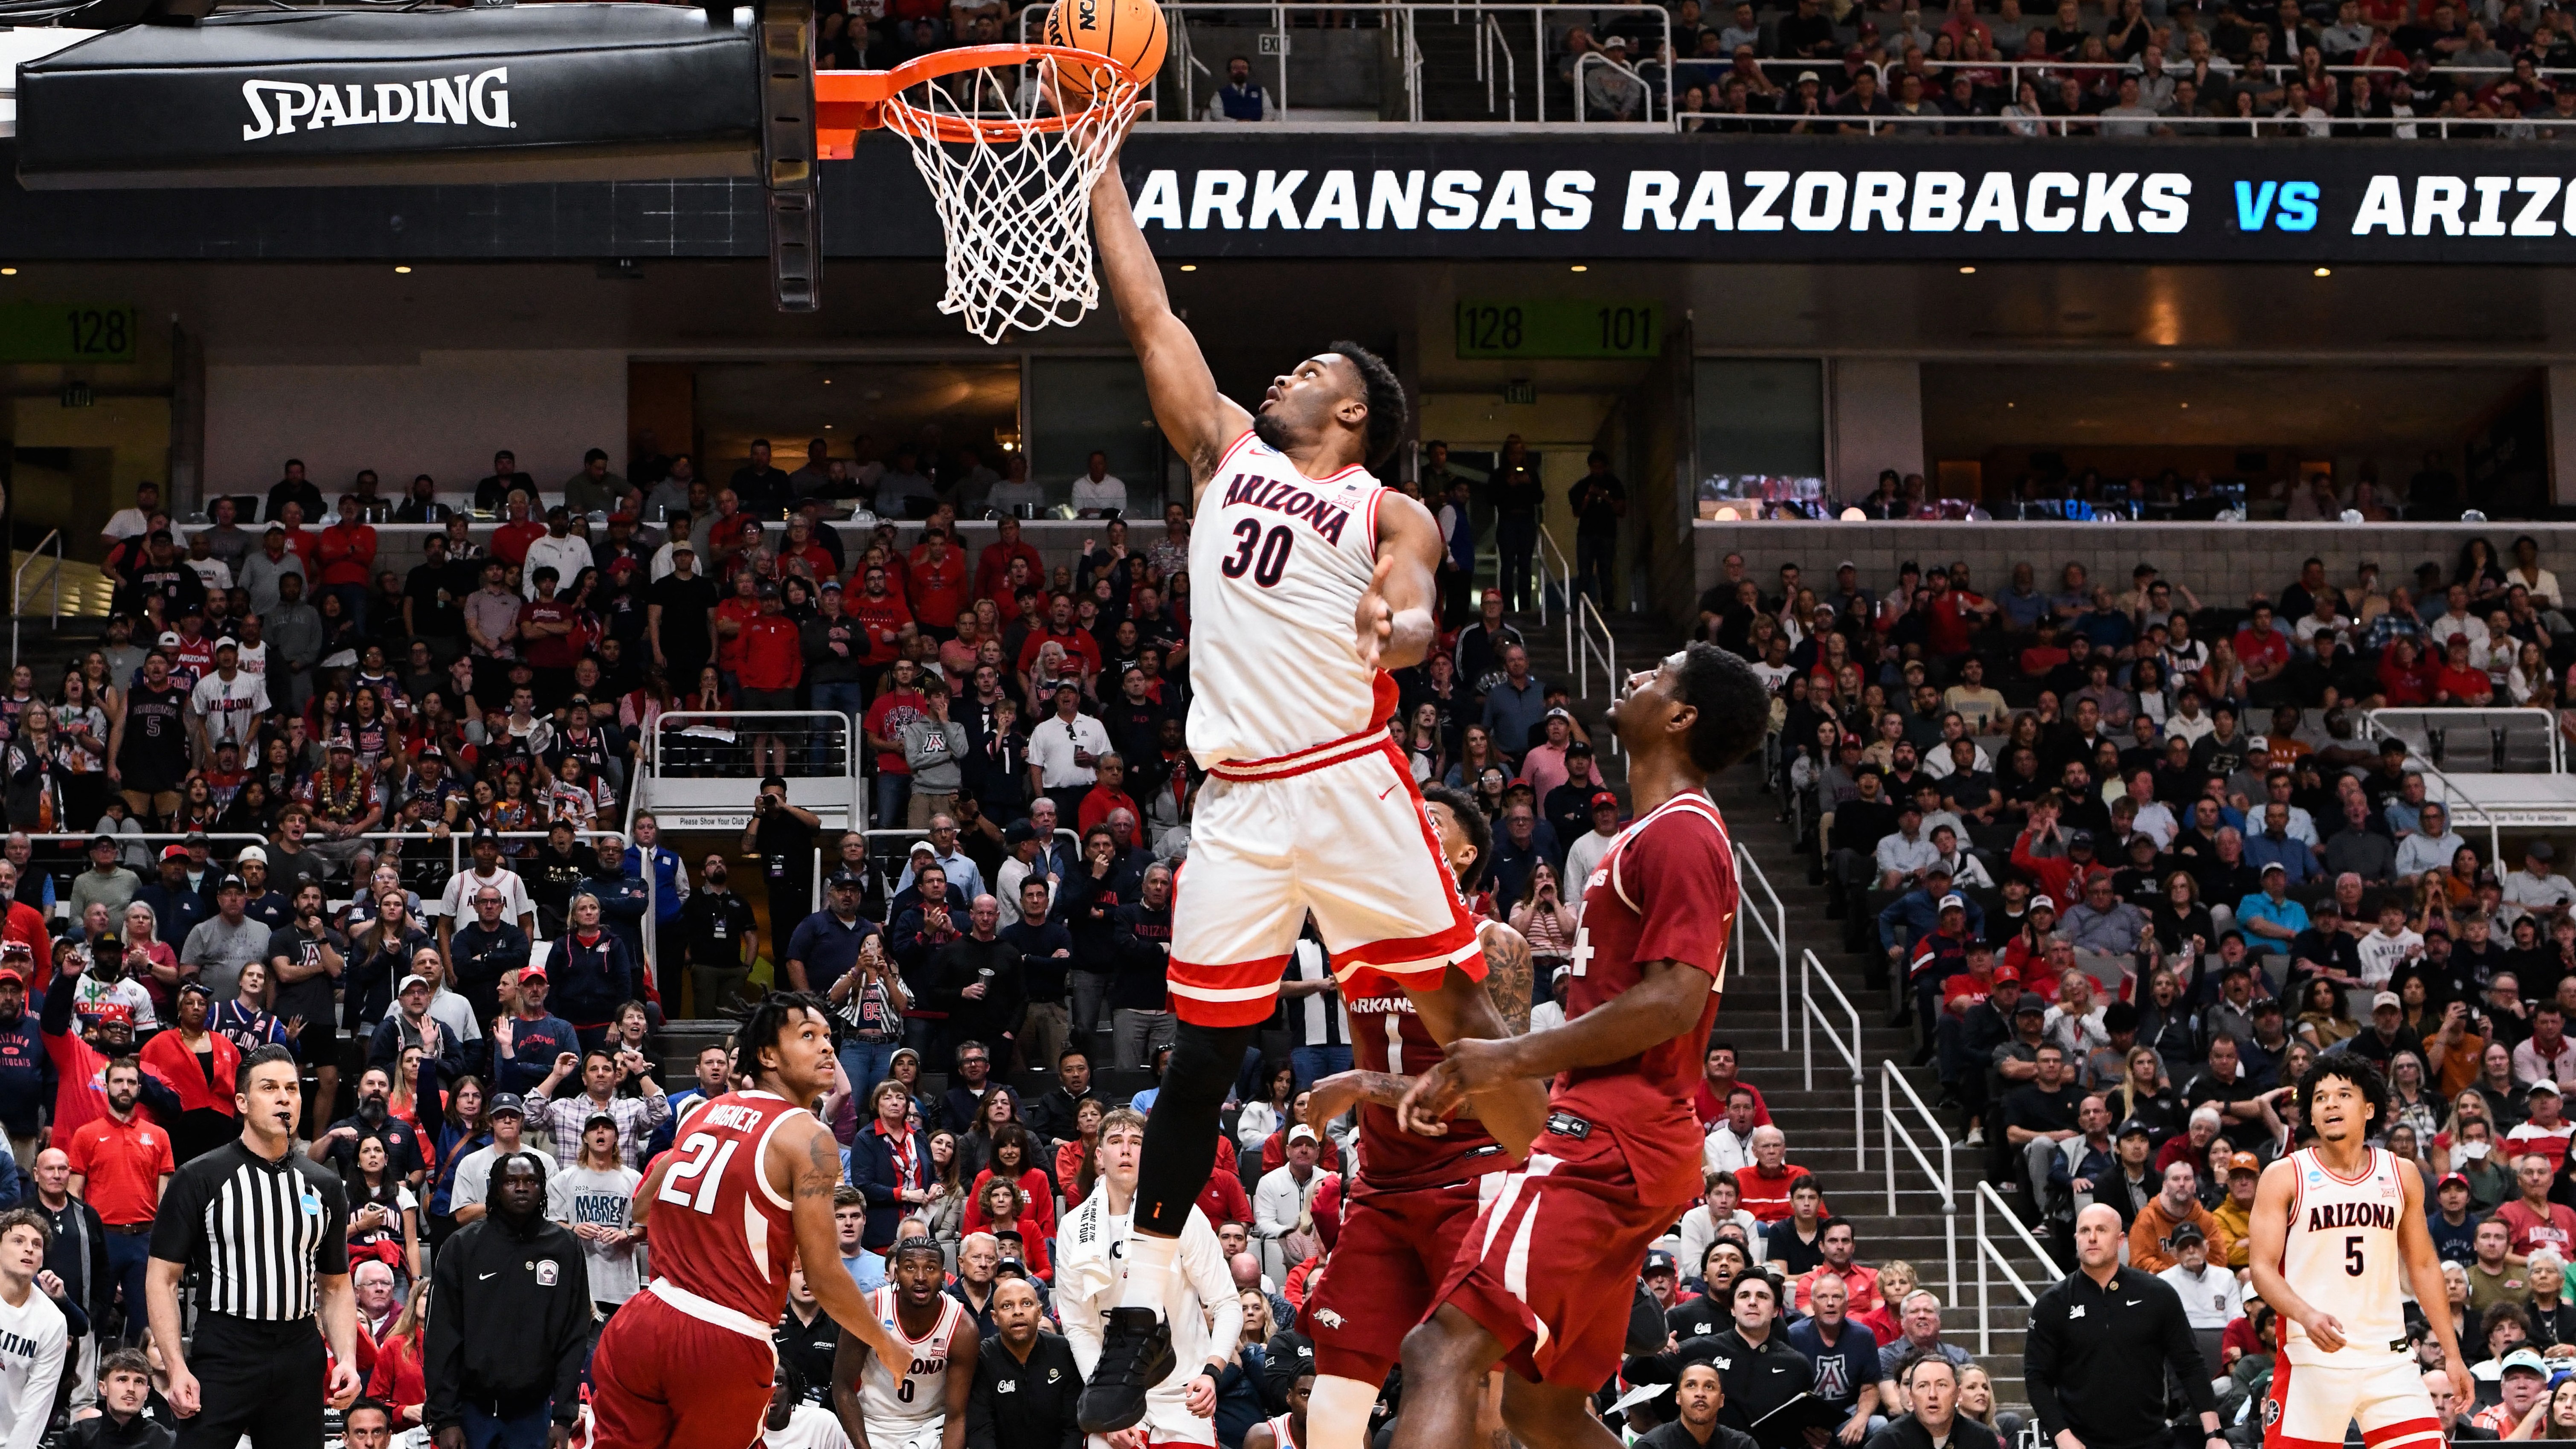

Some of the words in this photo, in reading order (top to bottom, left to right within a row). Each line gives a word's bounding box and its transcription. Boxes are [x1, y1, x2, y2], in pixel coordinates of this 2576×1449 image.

[1080, 0, 1096, 31] NC
[242, 67, 509, 141] SPALDING
[1133, 170, 1595, 230] ARKANSAS
[1622, 171, 2192, 233] RAZORBACKS
[2234, 180, 2330, 232] VS
[2351, 175, 2576, 236] ARIZ
[68, 309, 127, 353] 128
[1466, 306, 1523, 350] 128
[1599, 307, 1650, 350] 101
[1508, 385, 1533, 403] EXIT
[1222, 474, 1350, 548] ARIZONA
[1222, 518, 1294, 588] 30
[178, 653, 210, 663] ARIZONA
[147, 715, 160, 737] 5
[680, 817, 698, 825] Please
[700, 817, 715, 825] Show
[717, 817, 729, 825] Your
[732, 817, 744, 825] Club
[863, 1002, 882, 1021] 85
[1350, 997, 1417, 1013] ARKANS
[518, 1034, 556, 1049] ARIZONA
[703, 1103, 763, 1133] WAGNER
[658, 1132, 740, 1215] 21
[576, 1195, 628, 1214] MARCH
[576, 1210, 623, 1224] MADNES
[1080, 1200, 1091, 1223] INAL
[2308, 1202, 2394, 1232] ARIZONA
[1079, 1222, 1089, 1245] FOUR
[2345, 1235, 2364, 1277] 5
[3, 1331, 20, 1353] IT
[18, 1337, 38, 1358] IN
[897, 1379, 915, 1404] 0
[997, 1379, 1016, 1394] Cats
